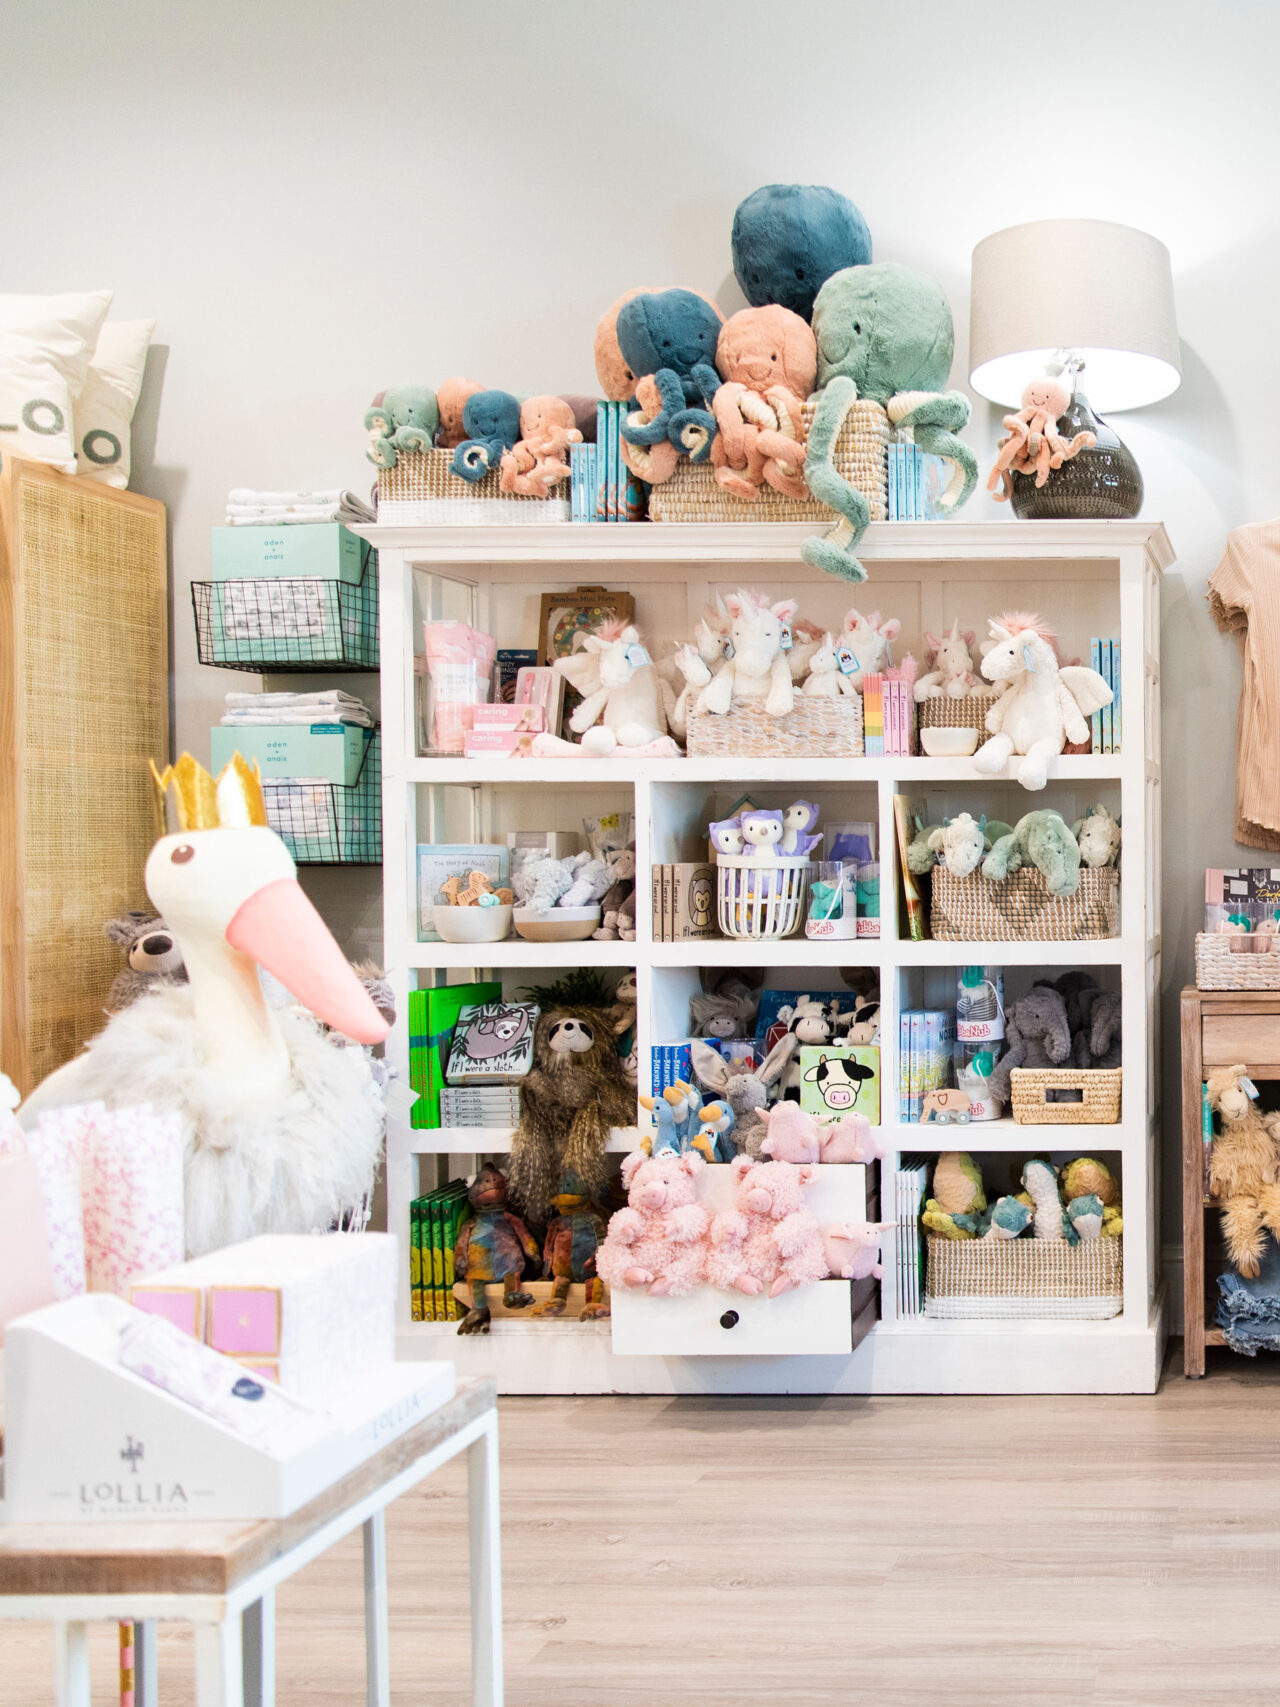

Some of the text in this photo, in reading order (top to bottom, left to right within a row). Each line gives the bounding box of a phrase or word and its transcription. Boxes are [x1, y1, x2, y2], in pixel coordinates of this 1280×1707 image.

[478, 707, 508, 717] caring
[471, 735, 503, 744] caring
[451, 1061, 460, 1073] If
[79, 1482, 189, 1504] LOLLIA
